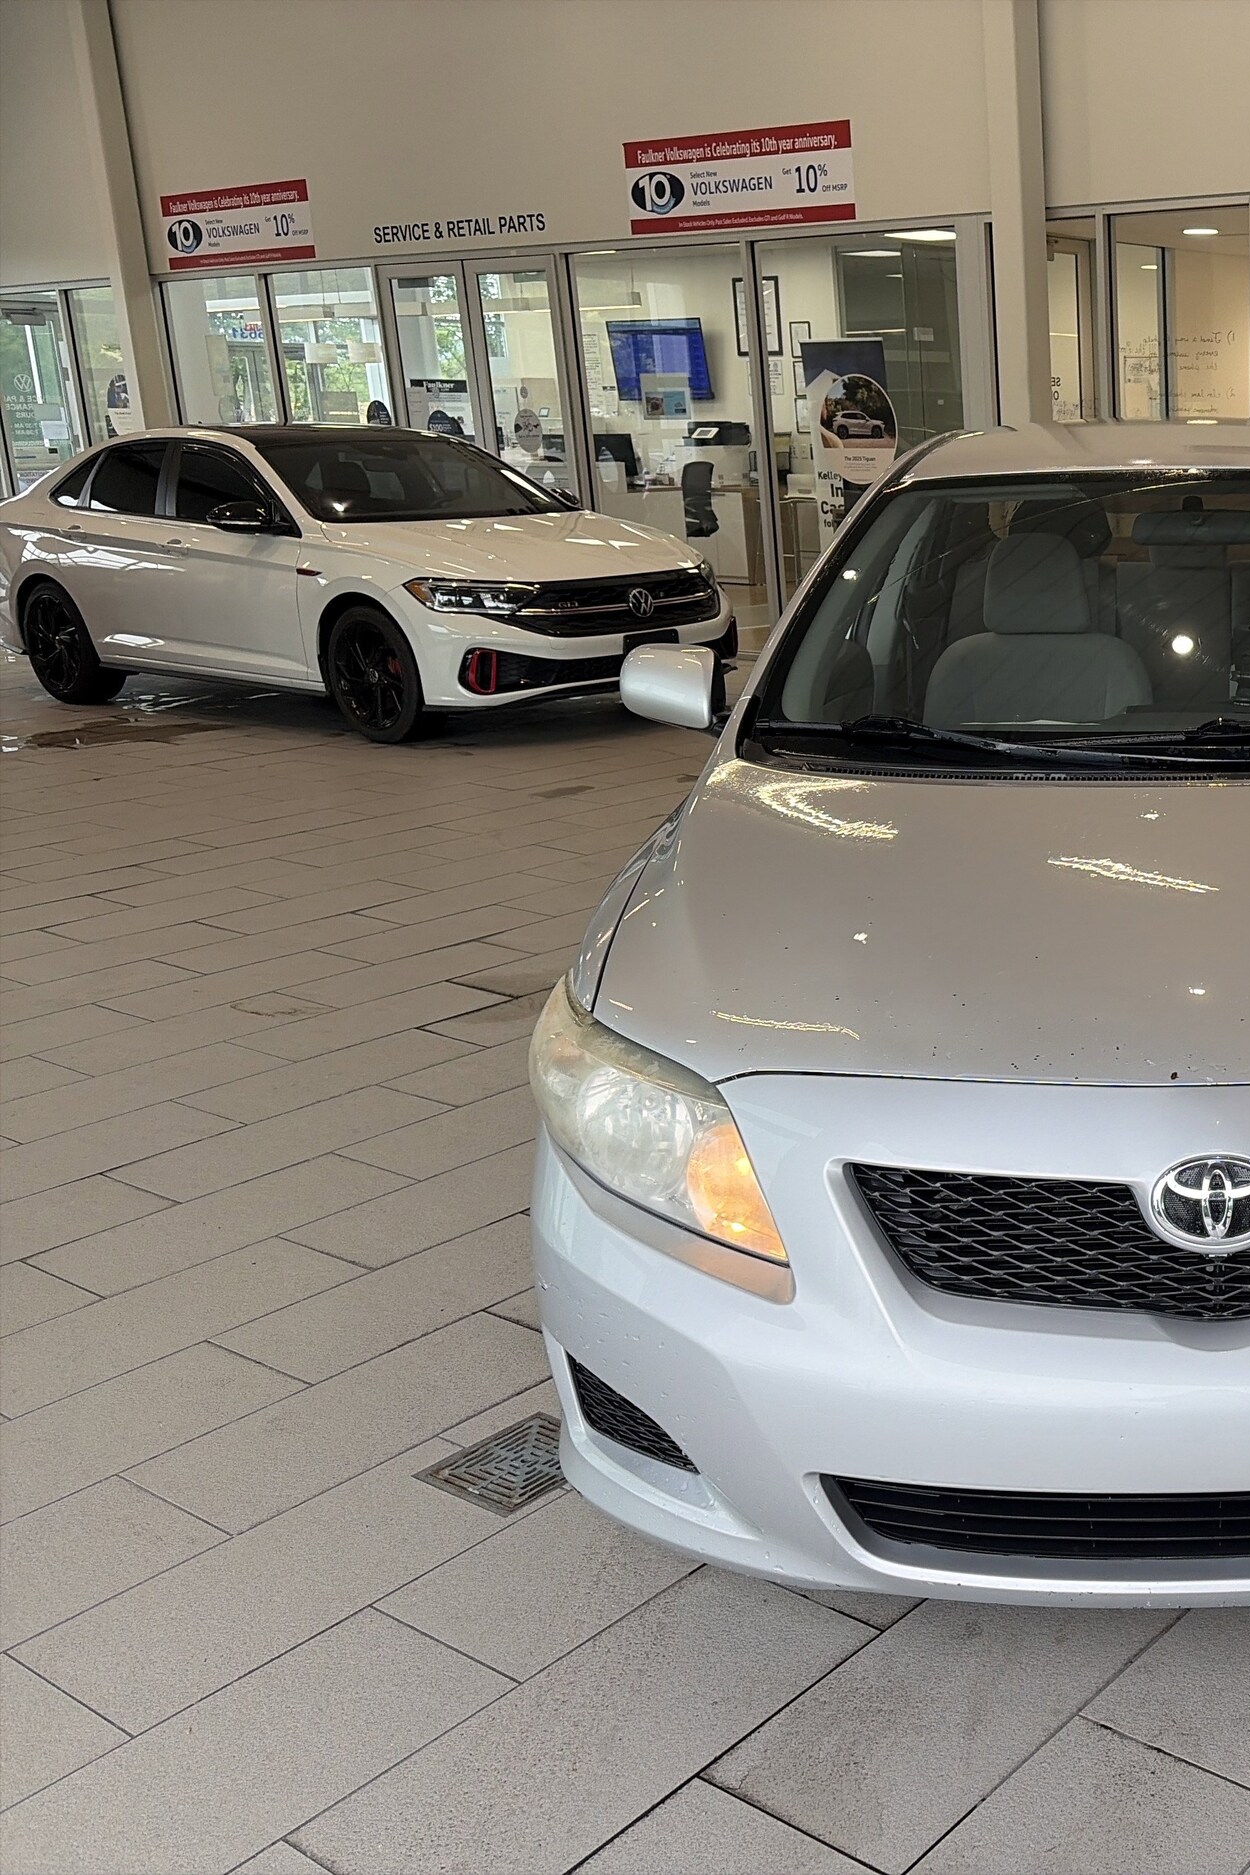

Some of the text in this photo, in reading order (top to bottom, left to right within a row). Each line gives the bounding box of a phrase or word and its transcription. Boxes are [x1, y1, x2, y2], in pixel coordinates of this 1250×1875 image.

[637, 150, 665, 164] Faulkner
[665, 146, 704, 162] Volkswagen
[705, 145, 711, 157] is
[711, 140, 750, 157] Celebrating
[761, 136, 778, 152] 10th
[778, 138, 794, 155] year
[795, 133, 837, 150] anniversary.
[690, 171, 705, 179] Select
[782, 168, 792, 176] Get
[638, 173, 672, 211] 10
[690, 175, 773, 196] VOLKSWAGEN
[822, 183, 848, 193] Off MSRP
[218, 195, 244, 208] Celebrating
[260, 193, 271, 206] year
[692, 199, 710, 208] Models
[172, 221, 194, 250] 10
[206, 223, 260, 238] VOLKSWAGEN
[374, 213, 546, 244] SERVICE & RETAIL PARTS
[423, 381, 455, 389] Faulkner
[818, 471, 842, 482] Kelley
